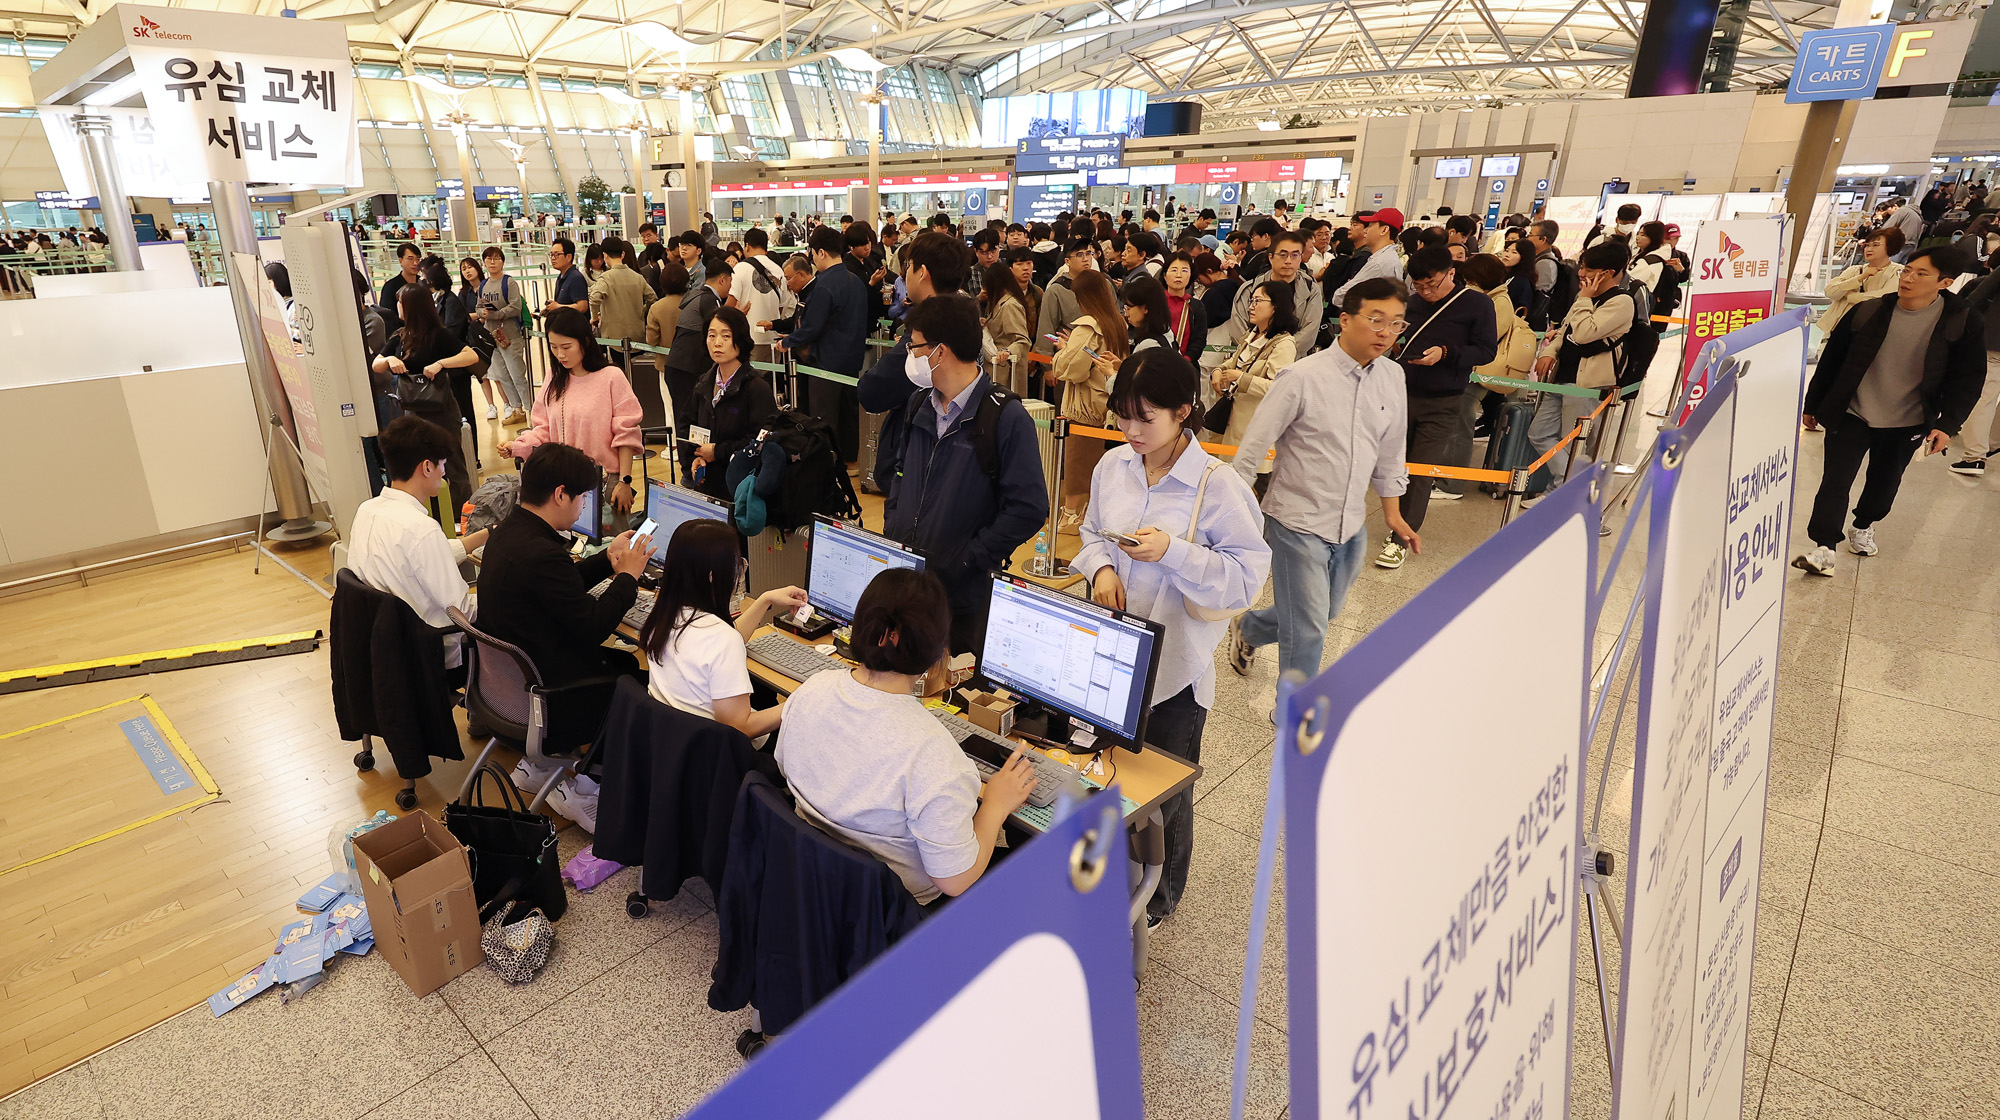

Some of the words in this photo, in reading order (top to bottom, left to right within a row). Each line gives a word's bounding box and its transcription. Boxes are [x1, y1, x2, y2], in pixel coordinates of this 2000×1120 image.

[133, 26, 150, 38] SK
[154, 31, 192, 41] telecom
[1816, 42, 1868, 67] 카트
[1887, 30, 1934, 78] F
[165, 57, 246, 103] 유심
[262, 66, 336, 112] 교체
[1808, 68, 1862, 83] CARTS
[208, 116, 317, 161] 서비스
[652, 139, 664, 161] F
[1020, 141, 1028, 153] 3
[1700, 257, 1725, 281] SK
[1733, 260, 1770, 279] 텔레콤
[1729, 446, 1788, 525] 심교체서비스
[1721, 500, 1783, 610] 이용안내
[1041, 705, 1058, 716] Lenovo
[131, 718, 145, 732] Here
[139, 730, 158, 748] Queue
[150, 746, 168, 764] Please
[1346, 976, 1410, 1120] 유심
[1417, 835, 1510, 1025] 교체만큼
[1516, 753, 1568, 877] 안전한
